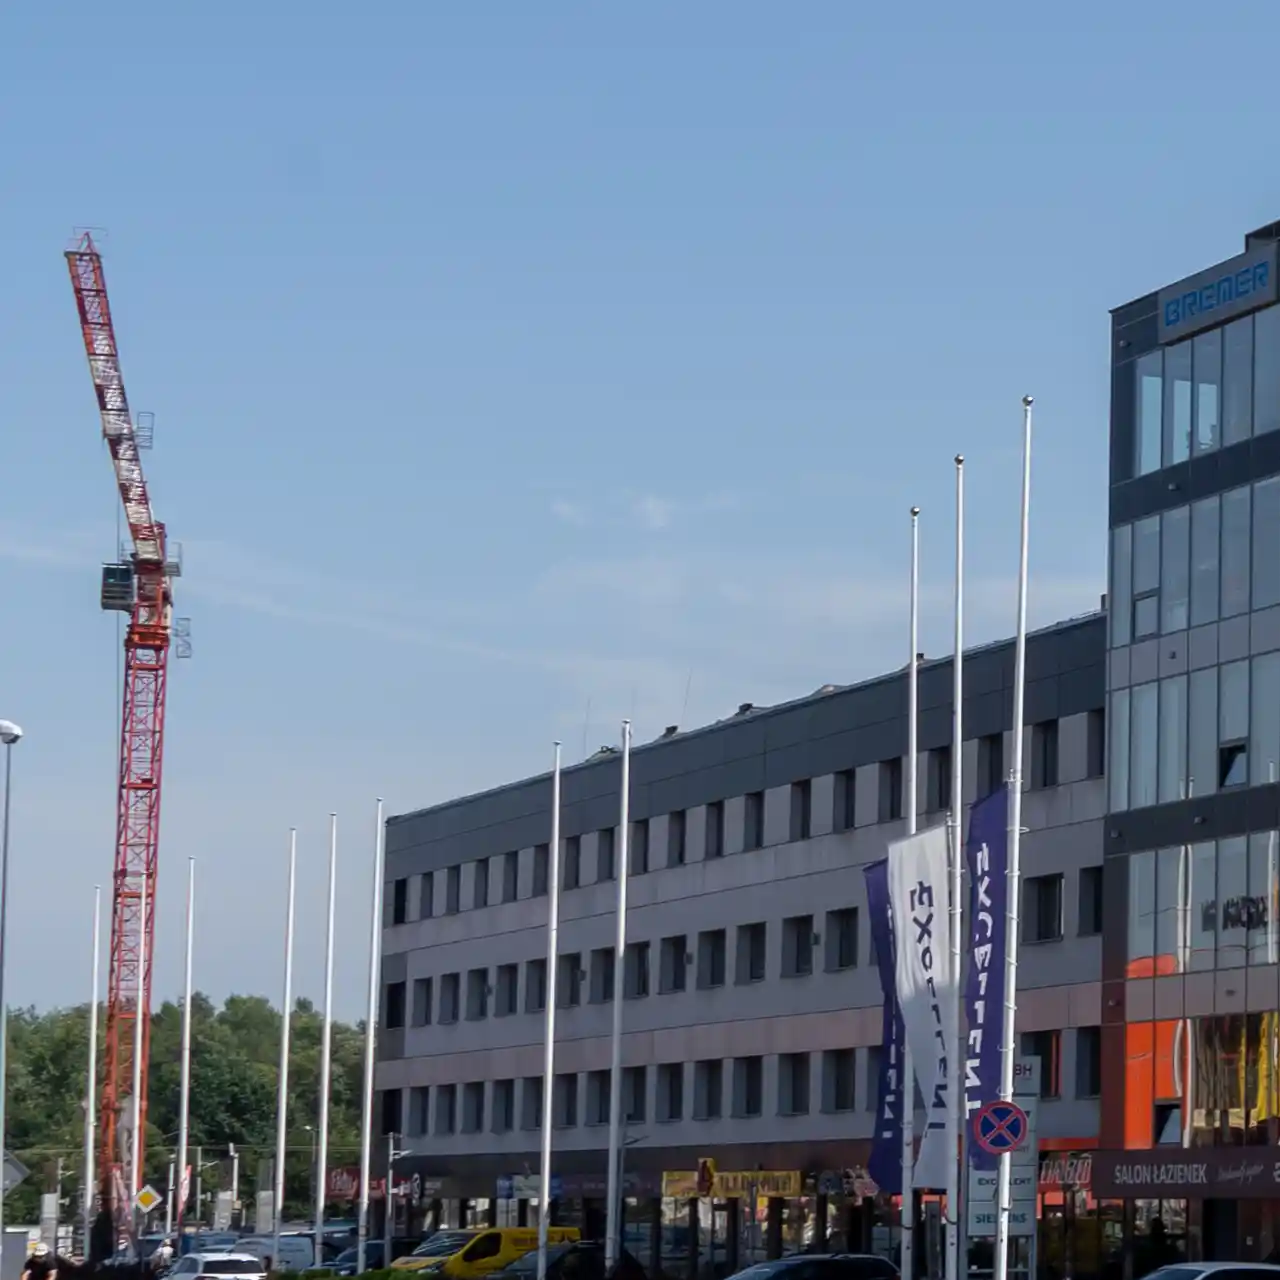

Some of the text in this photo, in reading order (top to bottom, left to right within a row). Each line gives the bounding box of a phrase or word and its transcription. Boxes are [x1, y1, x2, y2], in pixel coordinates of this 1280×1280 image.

[1164, 260, 1269, 327] BREMER
[977, 1177, 1032, 1186] EXCLENT
[1114, 1163, 1151, 1185] SALON
[1152, 1163, 1207, 1185] ŁAZIENEK
[975, 1213, 1027, 1224] SIEENS
